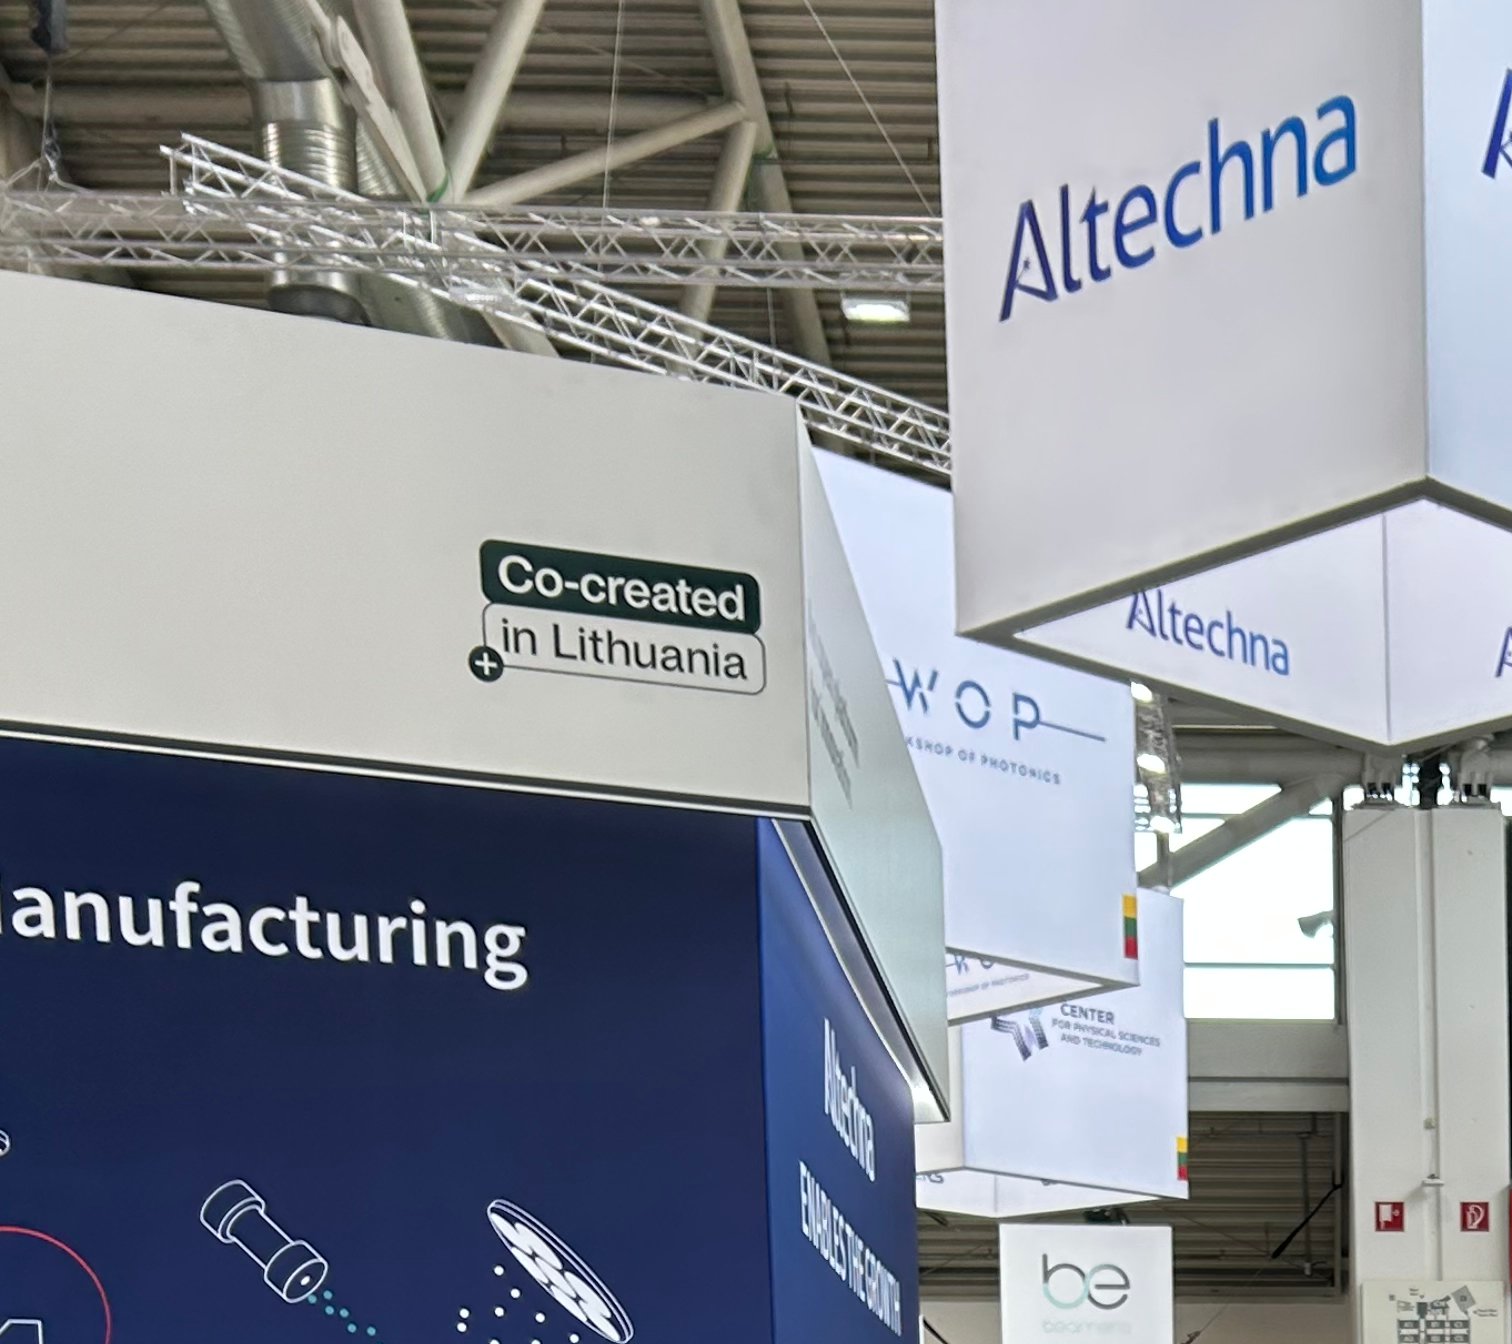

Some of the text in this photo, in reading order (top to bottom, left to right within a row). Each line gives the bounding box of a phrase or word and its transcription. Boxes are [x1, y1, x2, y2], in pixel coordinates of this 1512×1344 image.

[998, 94, 1357, 322] Altechna
[496, 552, 747, 623] Co-created
[500, 618, 748, 682] in Lithuania
[1125, 587, 1290, 678] Altechna
[0, 879, 530, 992] anufacturing
[1060, 1003, 1115, 1025] CENTER
[1042, 1253, 1131, 1310] be
